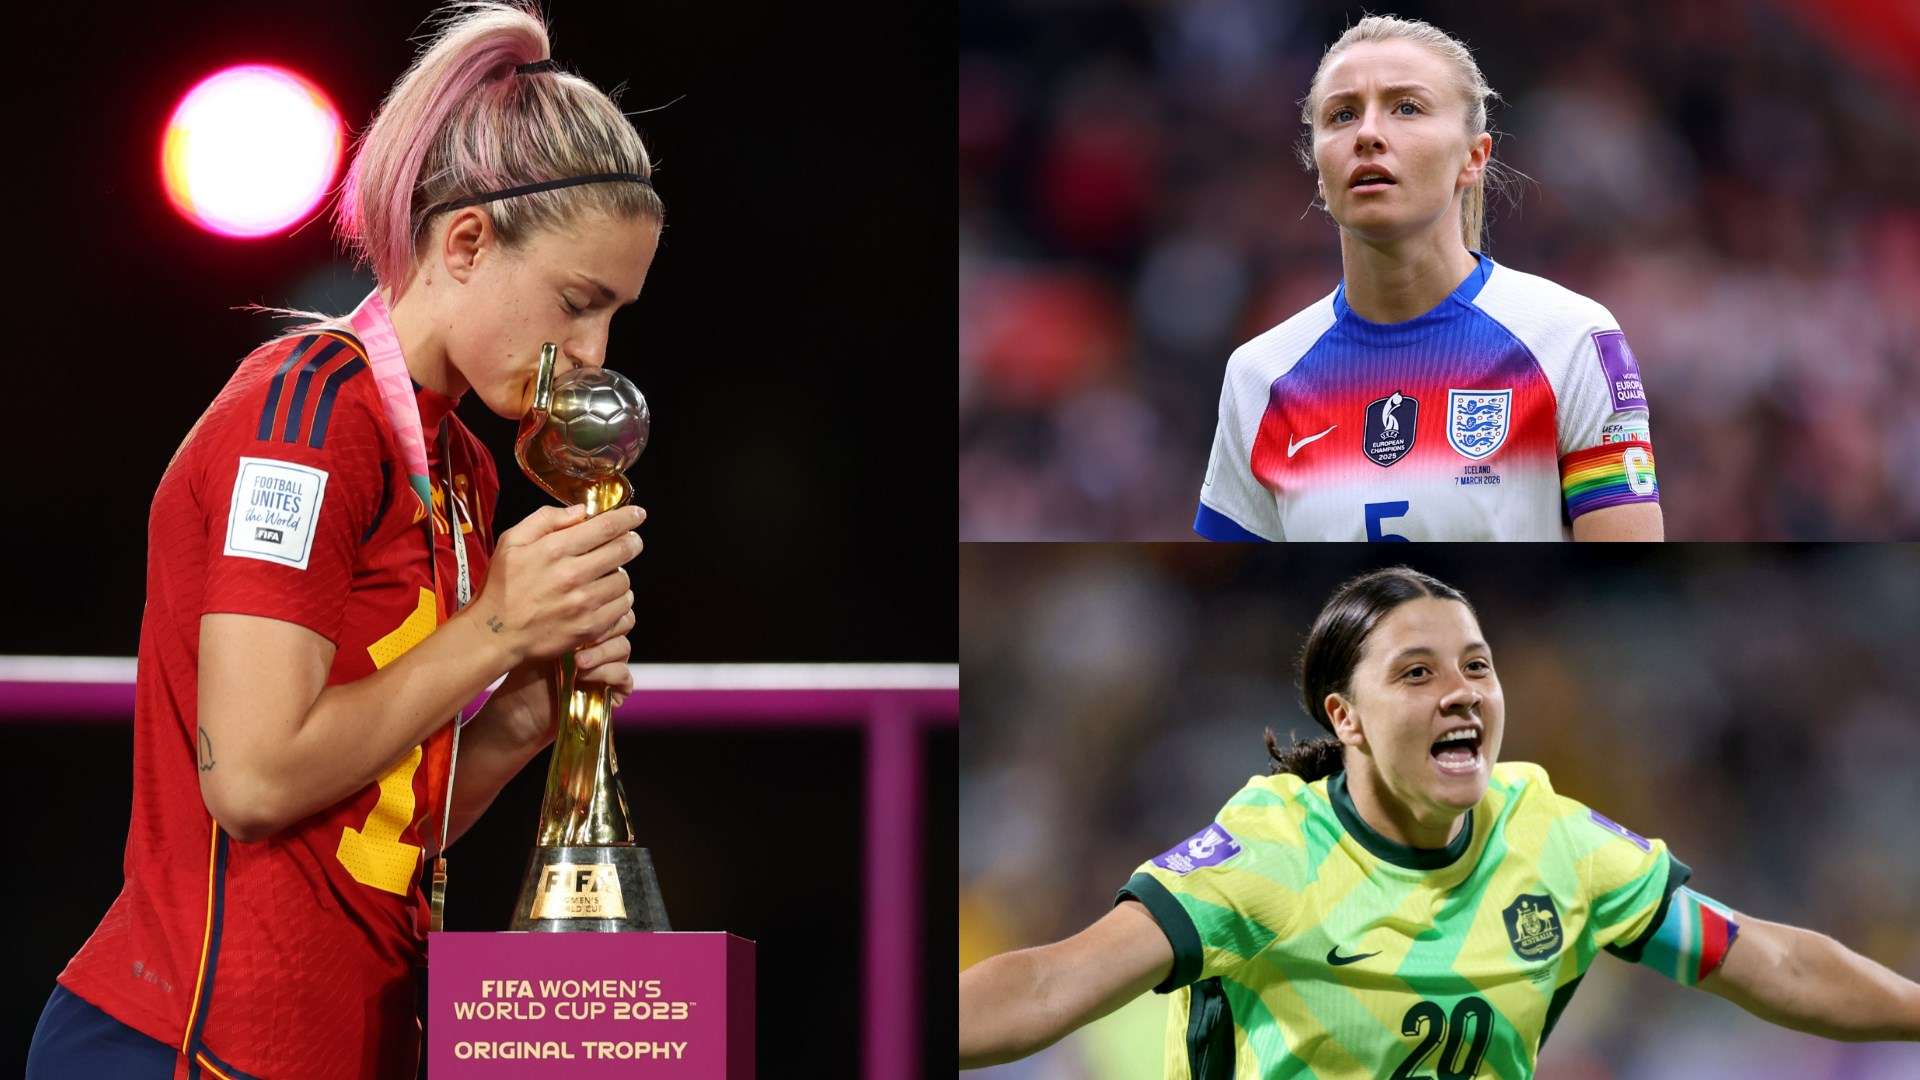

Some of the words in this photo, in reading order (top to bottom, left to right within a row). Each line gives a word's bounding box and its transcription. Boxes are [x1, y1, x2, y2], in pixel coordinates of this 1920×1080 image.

[1380, 429, 1400, 440] UEFA
[1602, 424, 1623, 433] UEFA
[1370, 445, 1405, 454] CHAMPIONS
[1372, 439, 1405, 448] EUROPEAN
[1464, 465, 1491, 474] ICELAND
[1623, 447, 1654, 496] C
[254, 475, 304, 496] FOOTBALL
[1460, 475, 1483, 485] MARCH
[1484, 475, 1501, 485] 2026
[250, 489, 302, 513] UNITES
[244, 508, 263, 522] the
[264, 510, 301, 531] World
[256, 529, 281, 543] FIFA
[562, 896, 599, 905] OMEN'S
[481, 980, 534, 998] FIFA
[539, 980, 662, 998] WOMEN'S
[454, 1001, 546, 1020] WORLD
[555, 1001, 606, 1020] CUP
[1389, 996, 1495, 1080] 20
[454, 1041, 575, 1060] ORIGINAL
[582, 1041, 688, 1060] TROPHY
